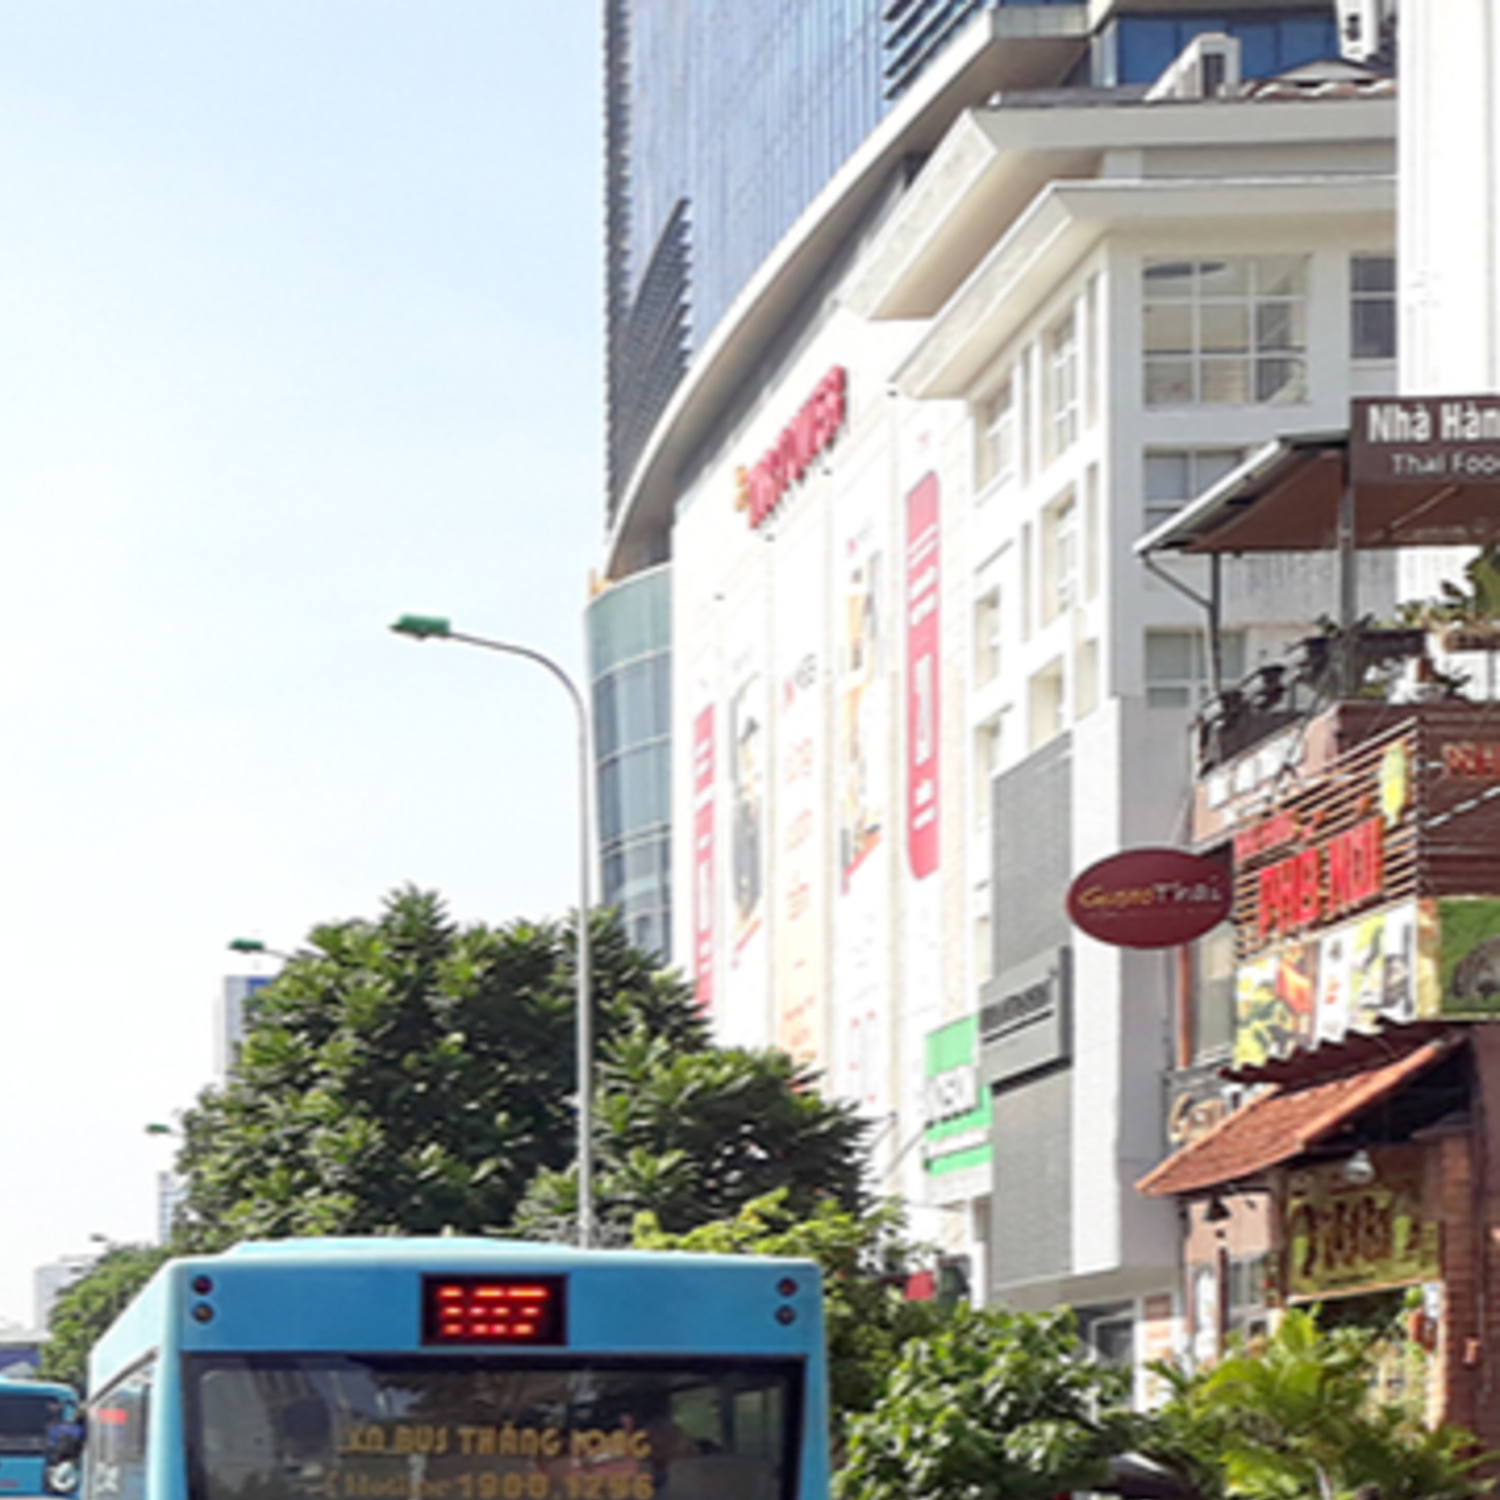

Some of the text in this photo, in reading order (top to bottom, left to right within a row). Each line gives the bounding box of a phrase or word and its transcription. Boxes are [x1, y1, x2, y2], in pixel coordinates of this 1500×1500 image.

[1369, 402, 1430, 442] Nhà
[1392, 450, 1500, 476] Thai Foo
[394, 1425, 448, 1453] BUS
